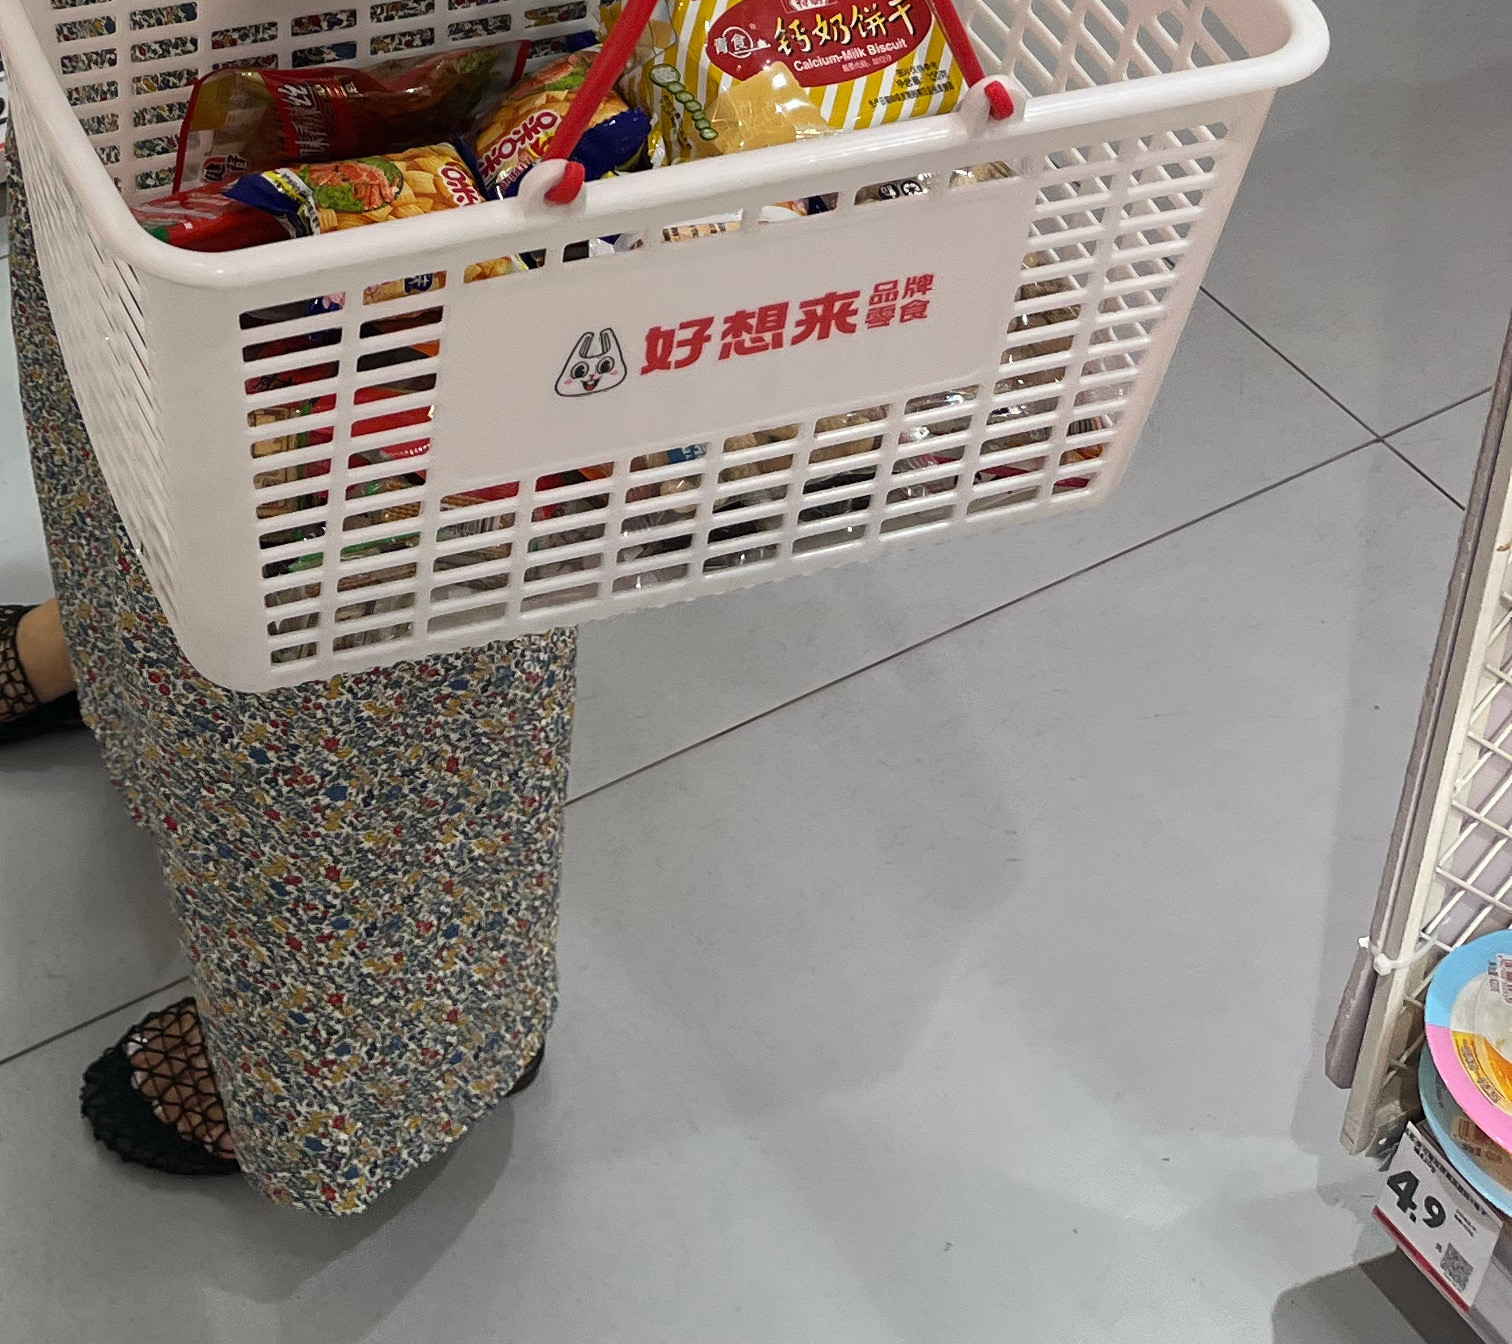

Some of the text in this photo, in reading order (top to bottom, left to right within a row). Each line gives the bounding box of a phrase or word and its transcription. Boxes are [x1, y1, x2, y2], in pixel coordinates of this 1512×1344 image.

[793, 37, 908, 72] Calcium-Milk Biscuit
[868, 274, 934, 306] 品牌
[865, 299, 930, 330] 零食
[639, 290, 860, 376] 好想来
[1387, 1170, 1447, 1228] 4.9
